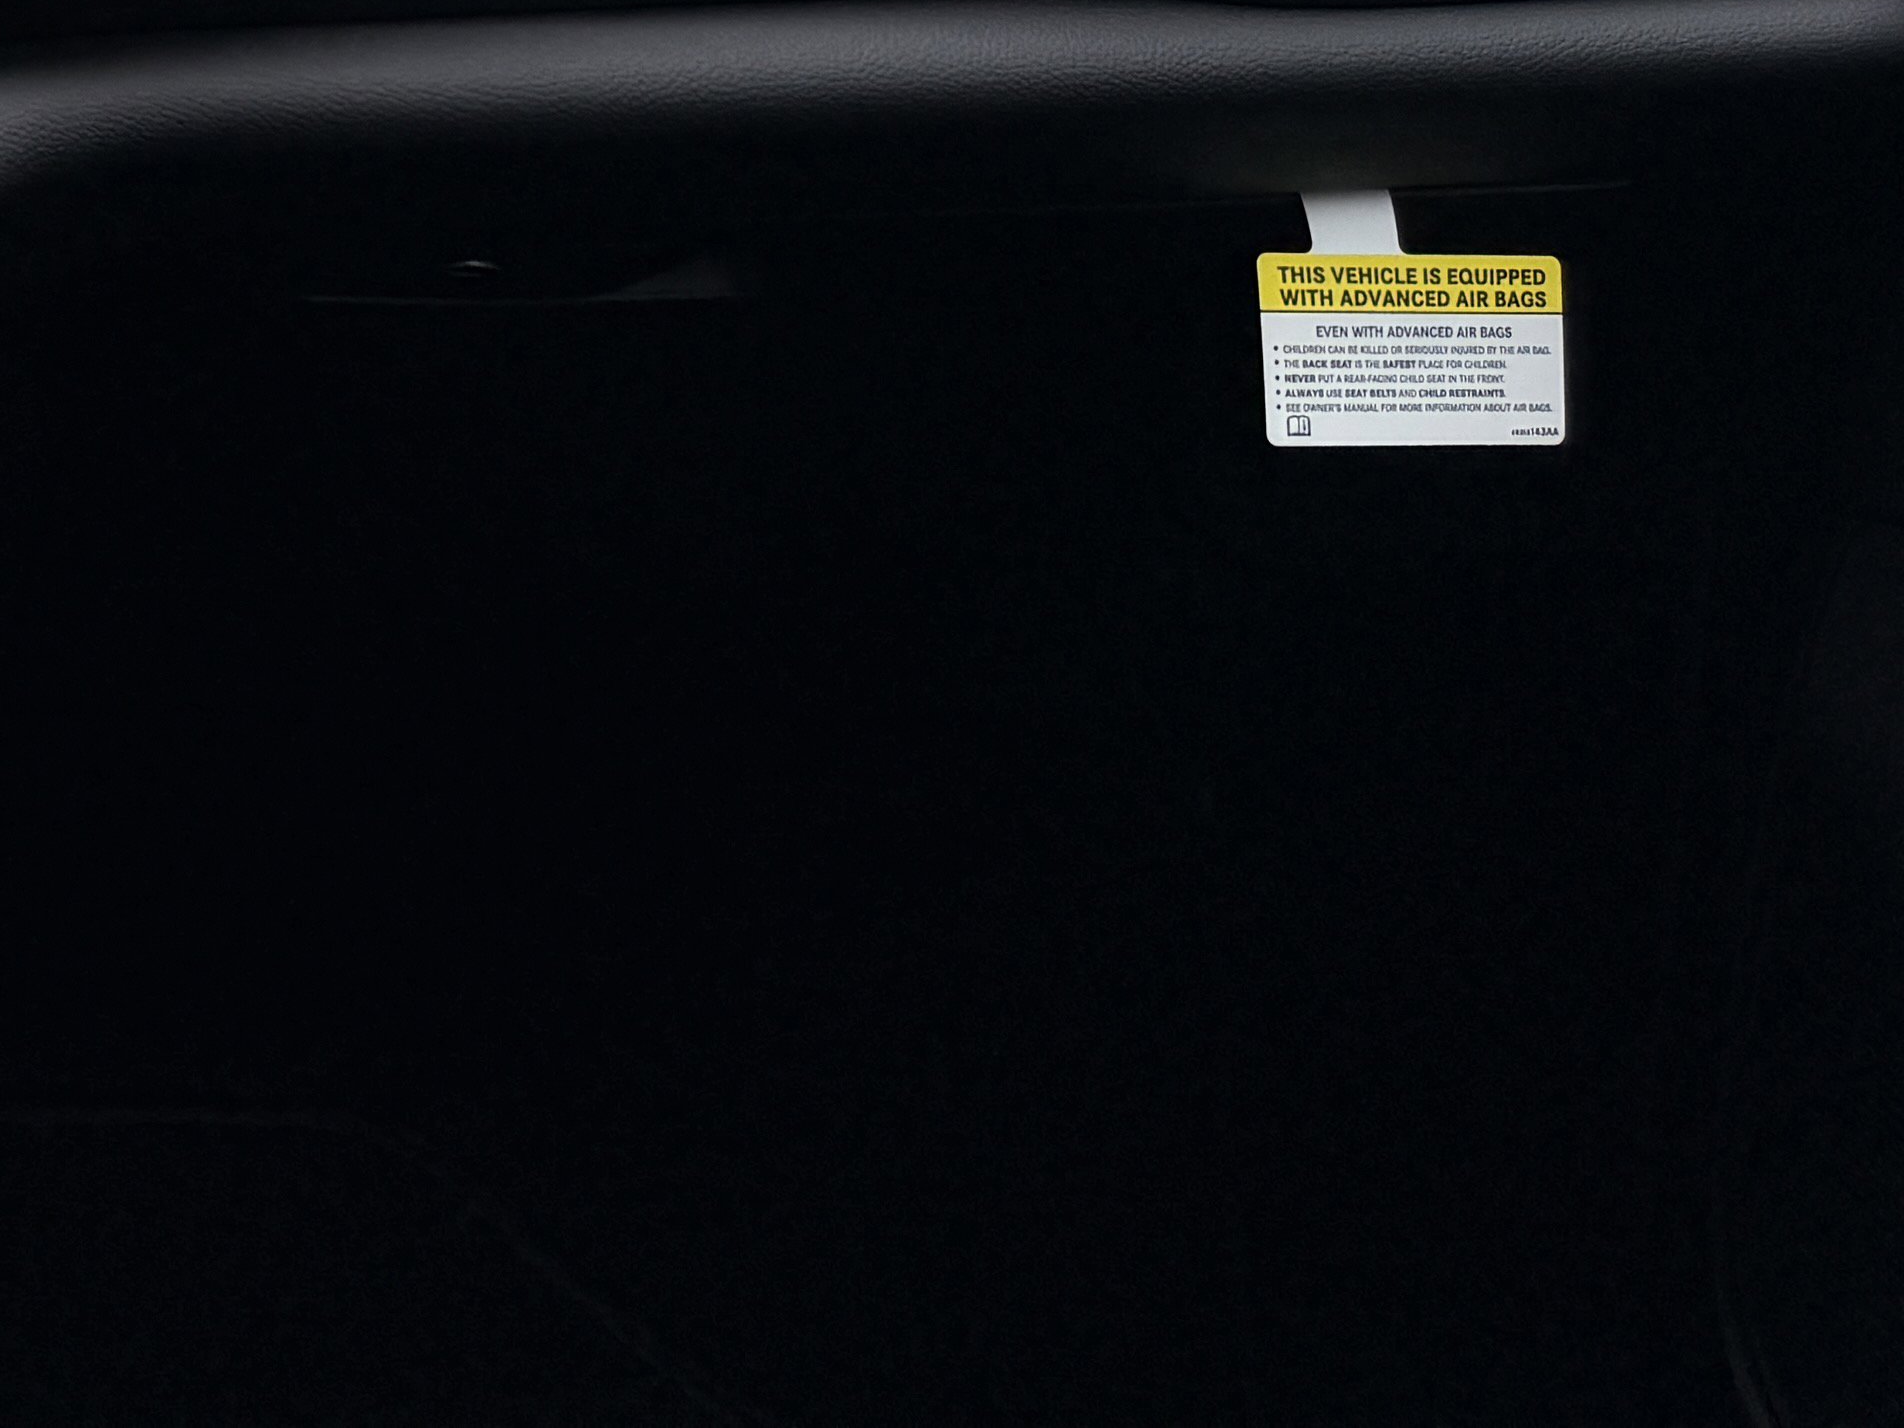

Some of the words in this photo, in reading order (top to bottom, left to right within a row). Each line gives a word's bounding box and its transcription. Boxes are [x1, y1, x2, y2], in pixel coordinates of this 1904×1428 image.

[1278, 266, 1326, 284] THIS
[1331, 267, 1418, 284] VEHICLE
[1424, 268, 1441, 284] IS
[1447, 268, 1546, 286] EQUIPPED
[1280, 289, 1333, 306] WITH
[1340, 290, 1450, 307] ADVANCED
[1456, 291, 1488, 307] AIR
[1495, 291, 1547, 308] BAGS
[1316, 326, 1348, 338] EVEN
[1351, 326, 1383, 338] WITH
[1387, 327, 1453, 338] ADVANCED
[1457, 327, 1476, 338] AIR
[1480, 327, 1512, 339] BAGS
[1328, 345, 1345, 355] CAN
[1302, 360, 1327, 369] BACK
[1330, 360, 1352, 369] SEAT
[1383, 360, 1416, 369] SAFEST
[1284, 374, 1315, 383] NEVER
[1426, 374, 1445, 383] SEAT
[1285, 389, 1324, 398] ALWAYS
[1326, 389, 1342, 398] USE
[1345, 389, 1367, 398] SEAT
[1370, 389, 1397, 398] BELTS
[1398, 389, 1417, 398] AND
[1419, 389, 1447, 398] CHILD
[1381, 403, 1397, 413] FOR
